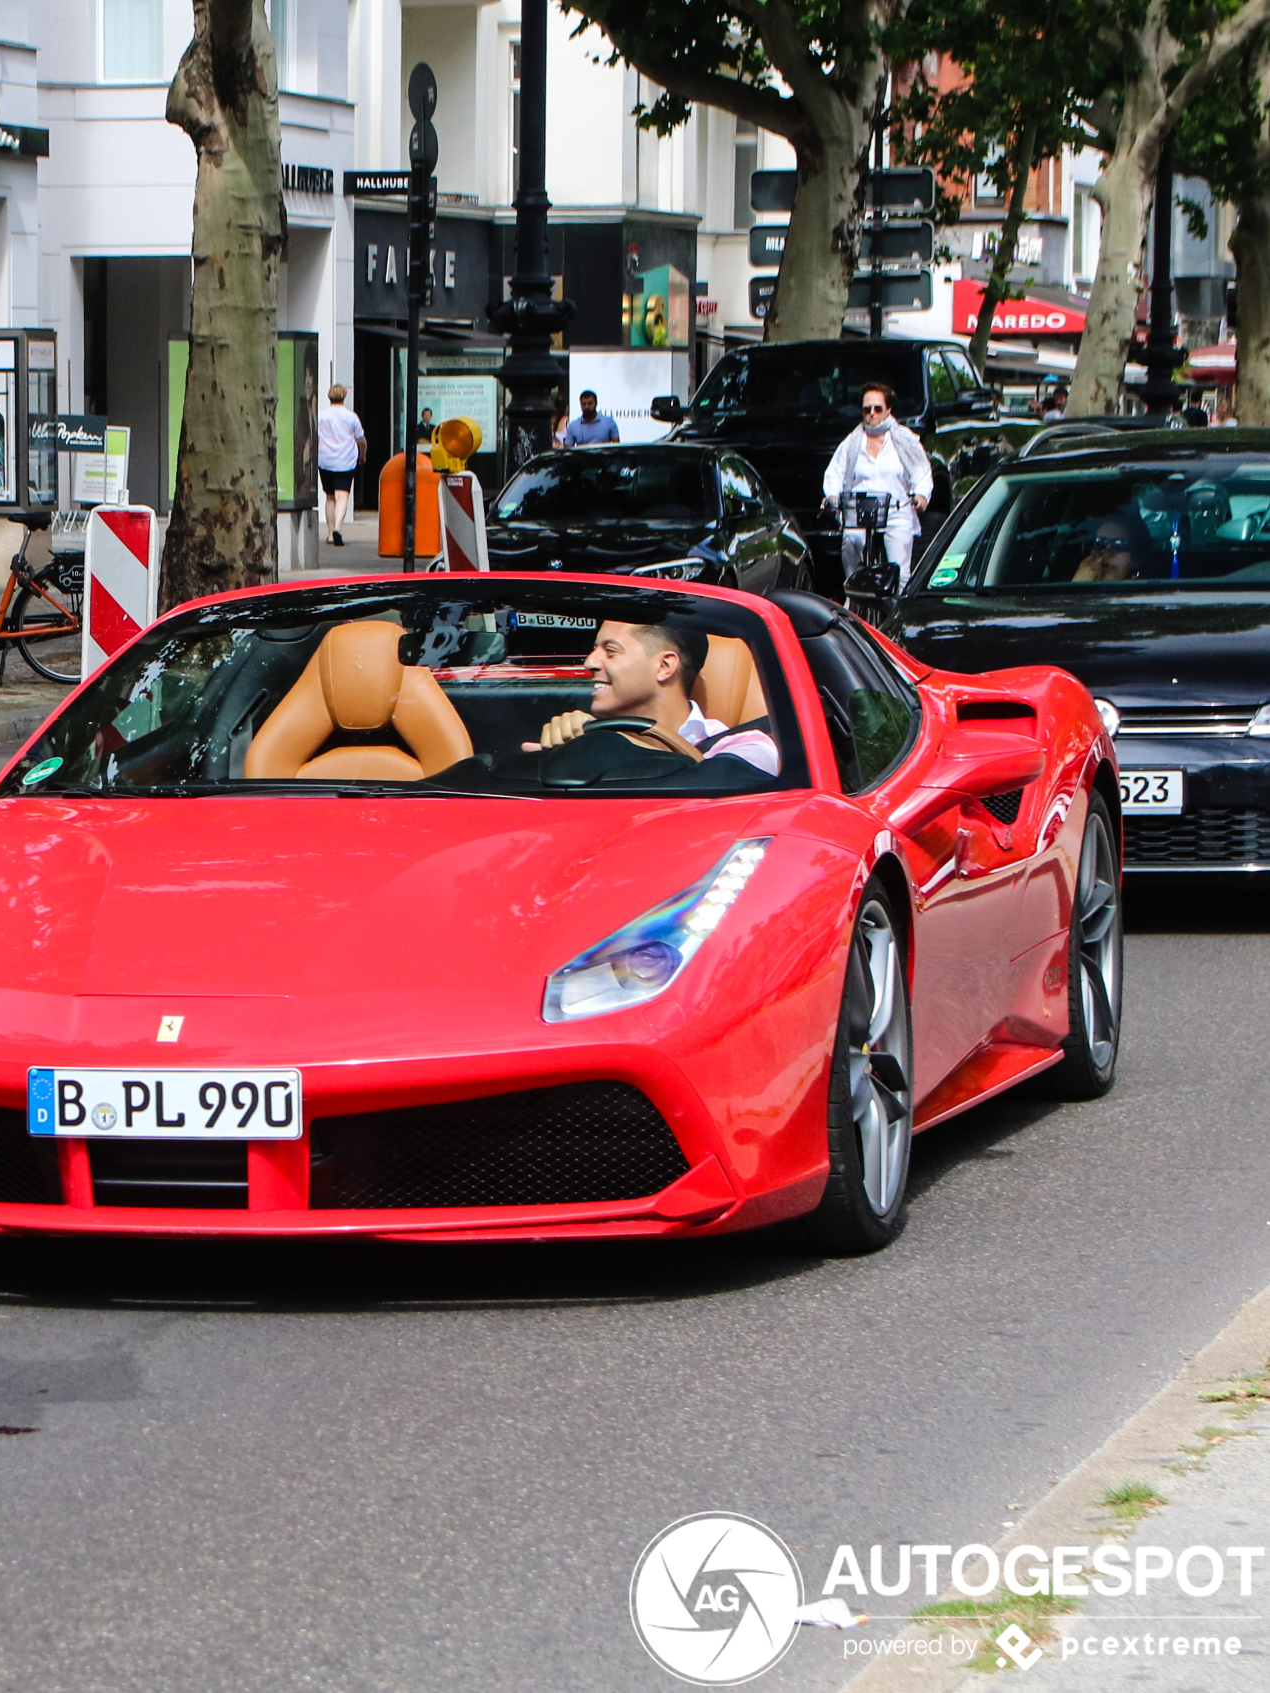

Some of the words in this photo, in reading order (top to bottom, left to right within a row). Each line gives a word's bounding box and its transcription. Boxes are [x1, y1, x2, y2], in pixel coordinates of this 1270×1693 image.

[356, 177, 409, 189] HALLHUBE
[598, 408, 649, 418] ALLHUBER
[57, 422, 103, 445] Popken
[518, 614, 527, 624] B
[536, 615, 555, 626] GB
[57, 1080, 86, 1127] B
[122, 1081, 186, 1128] PL
[198, 1081, 293, 1128] 990
[37, 1108, 48, 1122] D
